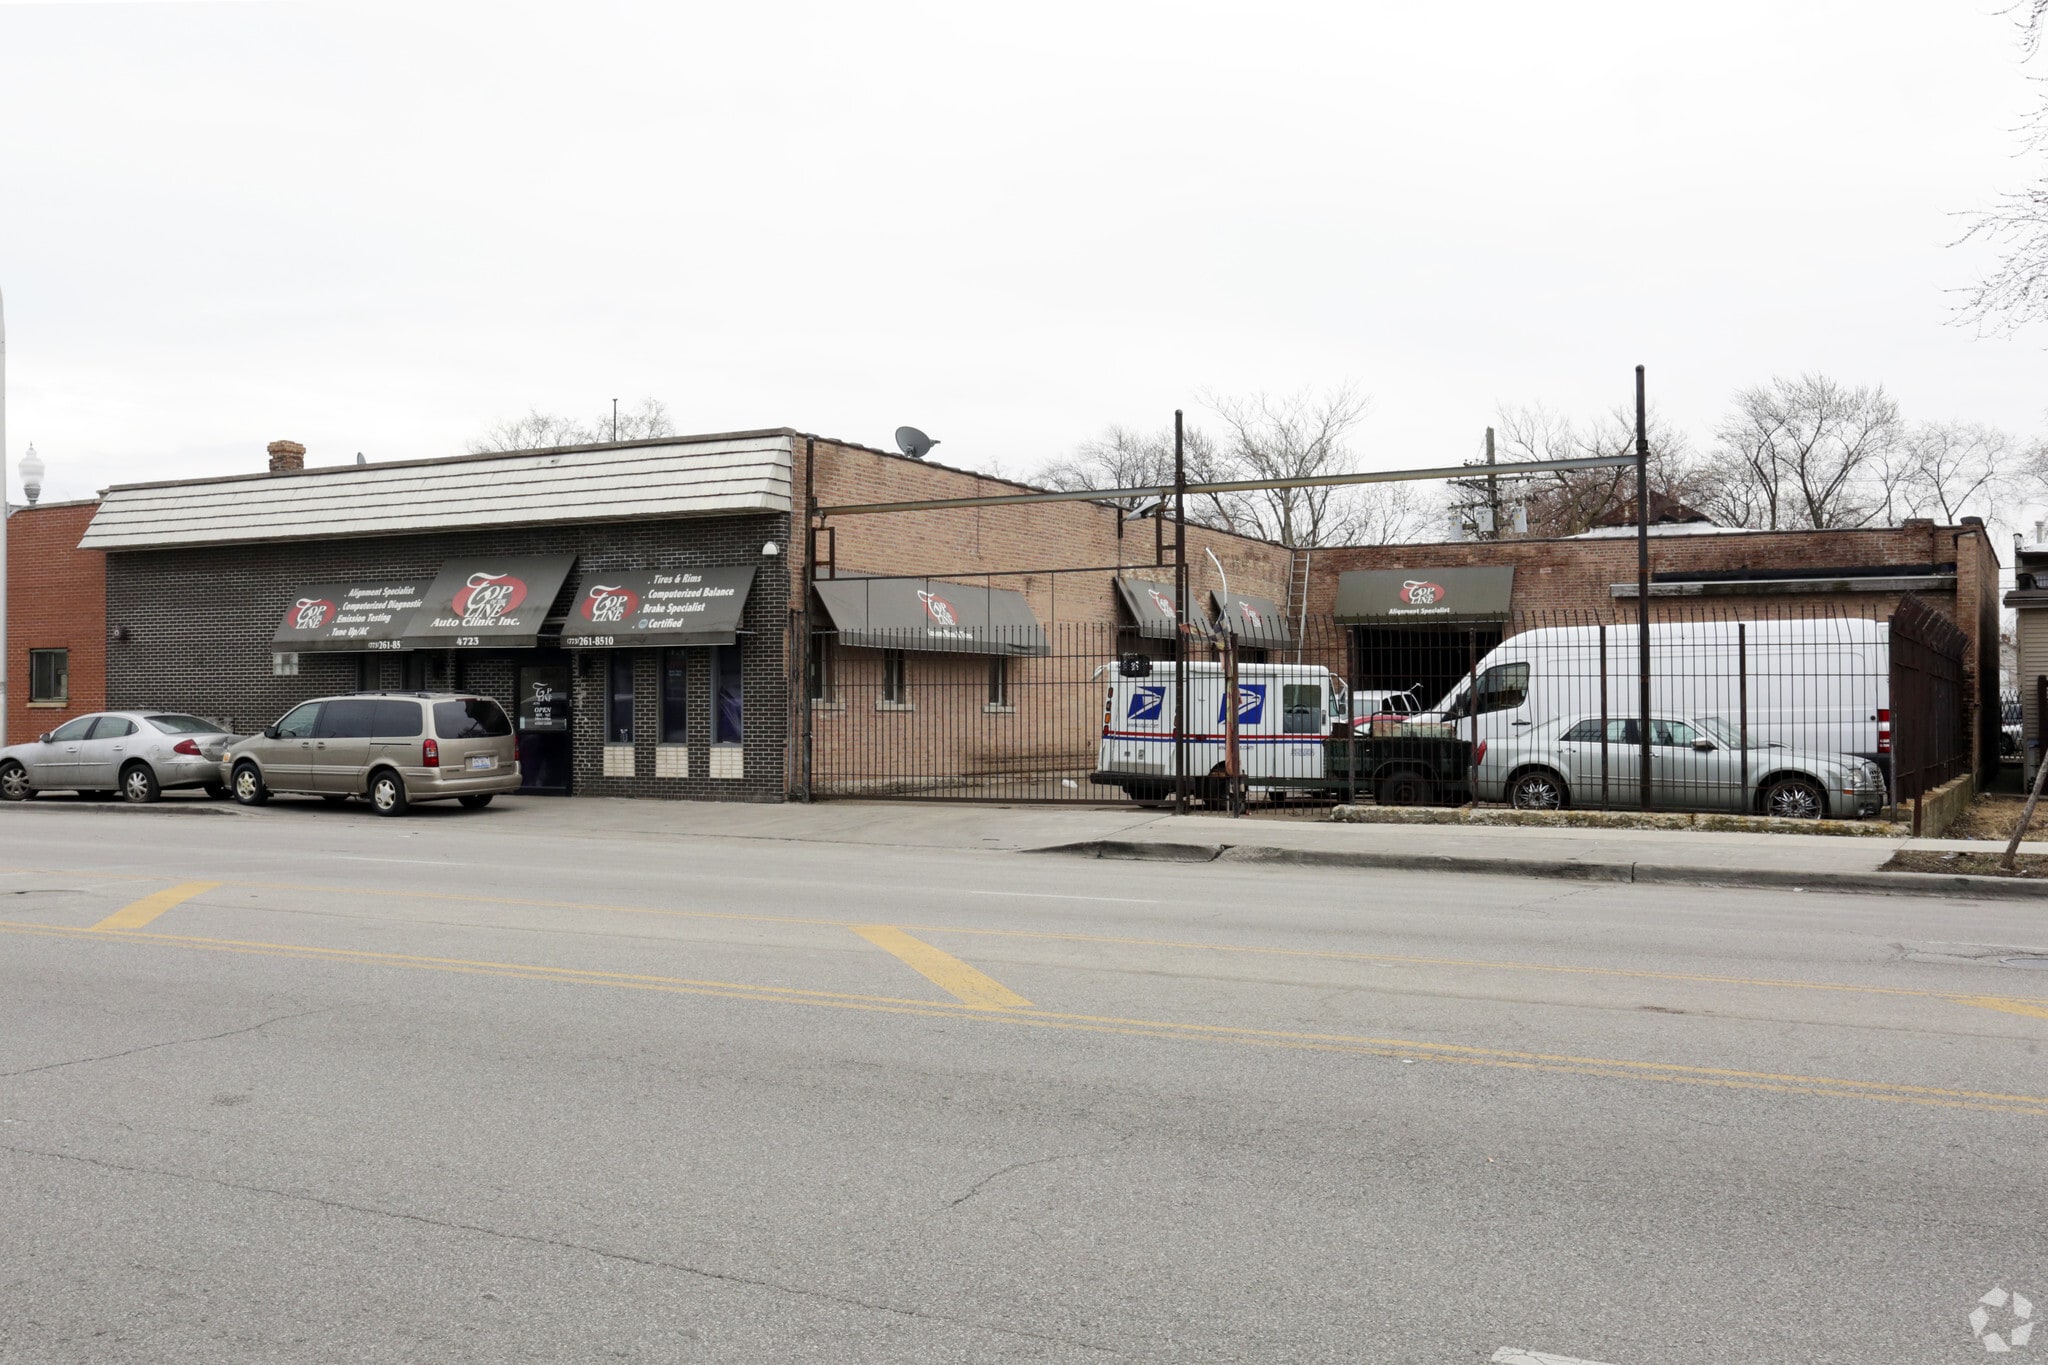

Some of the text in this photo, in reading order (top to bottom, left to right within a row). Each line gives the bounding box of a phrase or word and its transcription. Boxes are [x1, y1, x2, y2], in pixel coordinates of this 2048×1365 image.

[653, 573, 702, 584] Tires & Rims
[348, 586, 415, 599] Alignment Specialist
[648, 588, 734, 601] Computerized Balance
[342, 600, 387, 612] Computerized
[1411, 596, 1434, 605] LINE
[463, 604, 506, 618] LINE
[643, 603, 706, 615] Brake Specialist
[1388, 607, 1450, 616] Alignment Specialist
[336, 613, 392, 623] Emission Testing
[430, 616, 520, 628] Auto Clinic Inc.
[592, 611, 624, 622] LINE
[295, 619, 321, 629] LINE
[648, 618, 684, 628] Certified
[331, 627, 370, 638] Tune Up/AC
[456, 637, 479, 646] 4723
